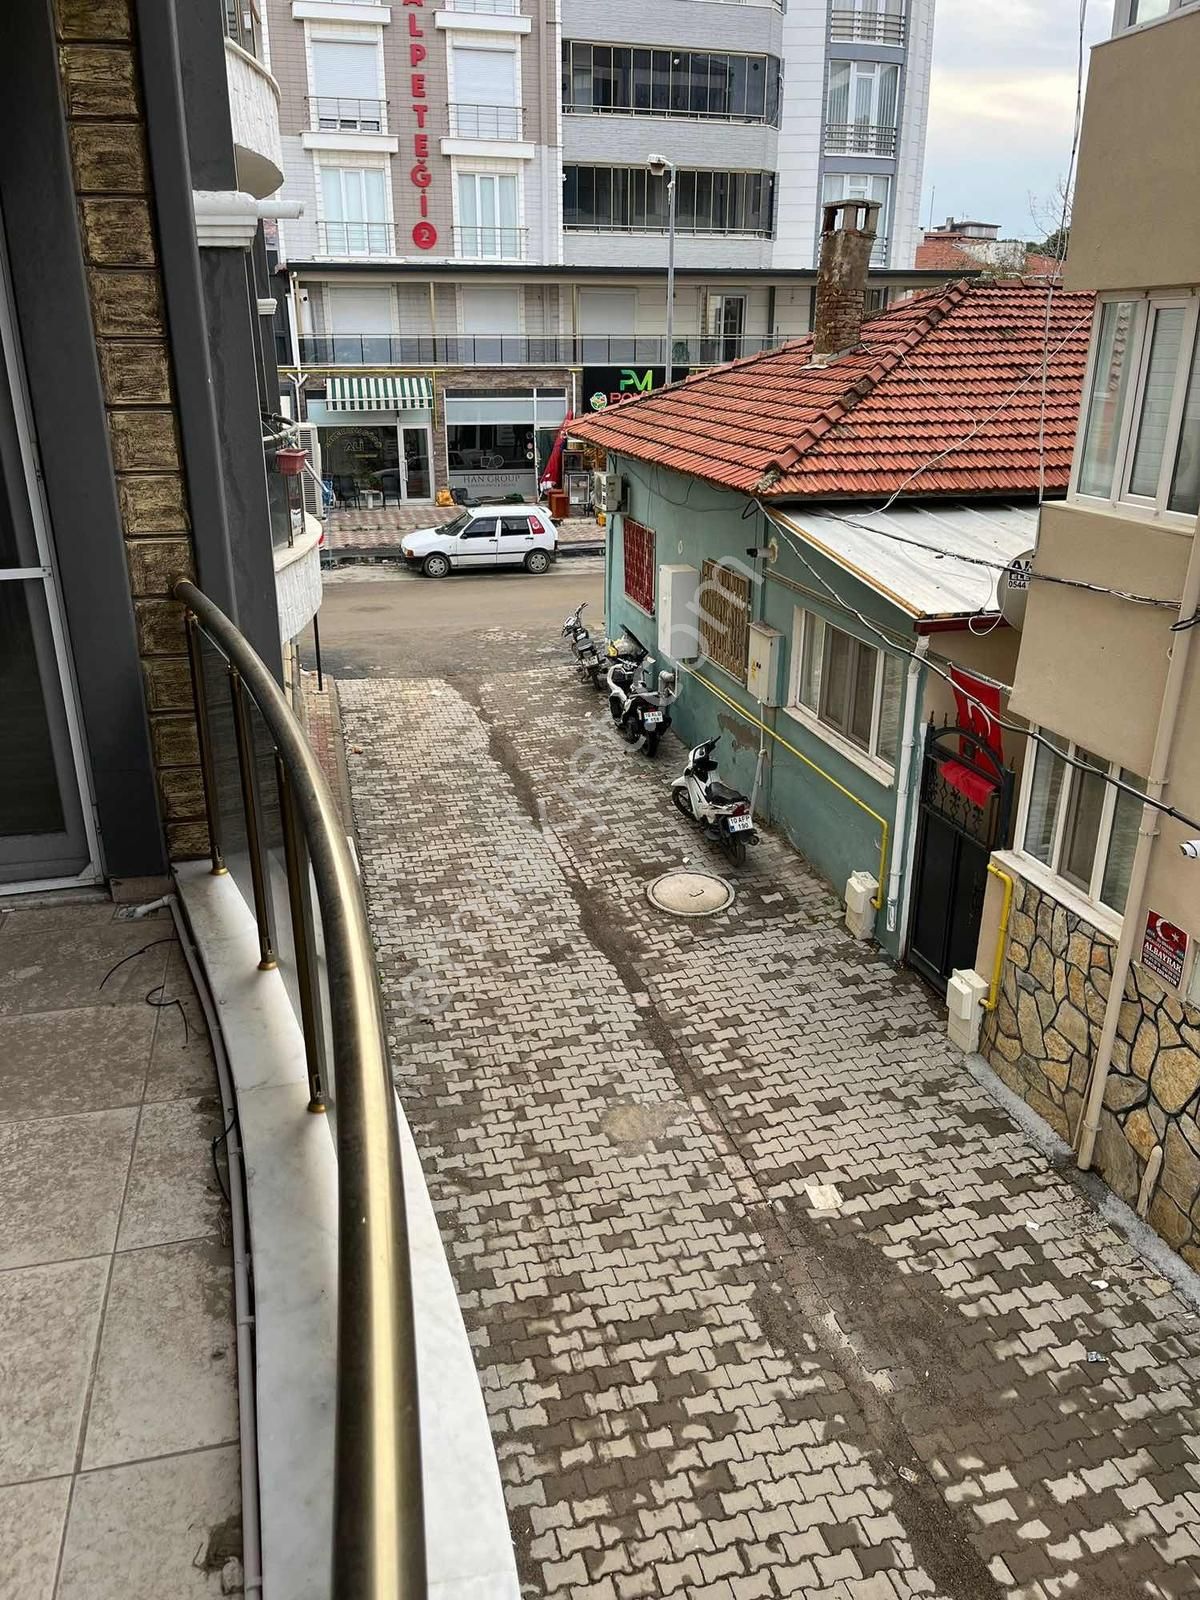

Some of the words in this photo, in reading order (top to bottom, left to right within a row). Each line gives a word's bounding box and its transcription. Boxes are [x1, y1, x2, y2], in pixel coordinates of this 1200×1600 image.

[620, 369, 653, 391] PM
[463, 474, 485, 484] HAN
[487, 474, 520, 483] GROUP
[1009, 581, 1026, 589] 0544
[1144, 941, 1182, 973] ALBAYRAK
